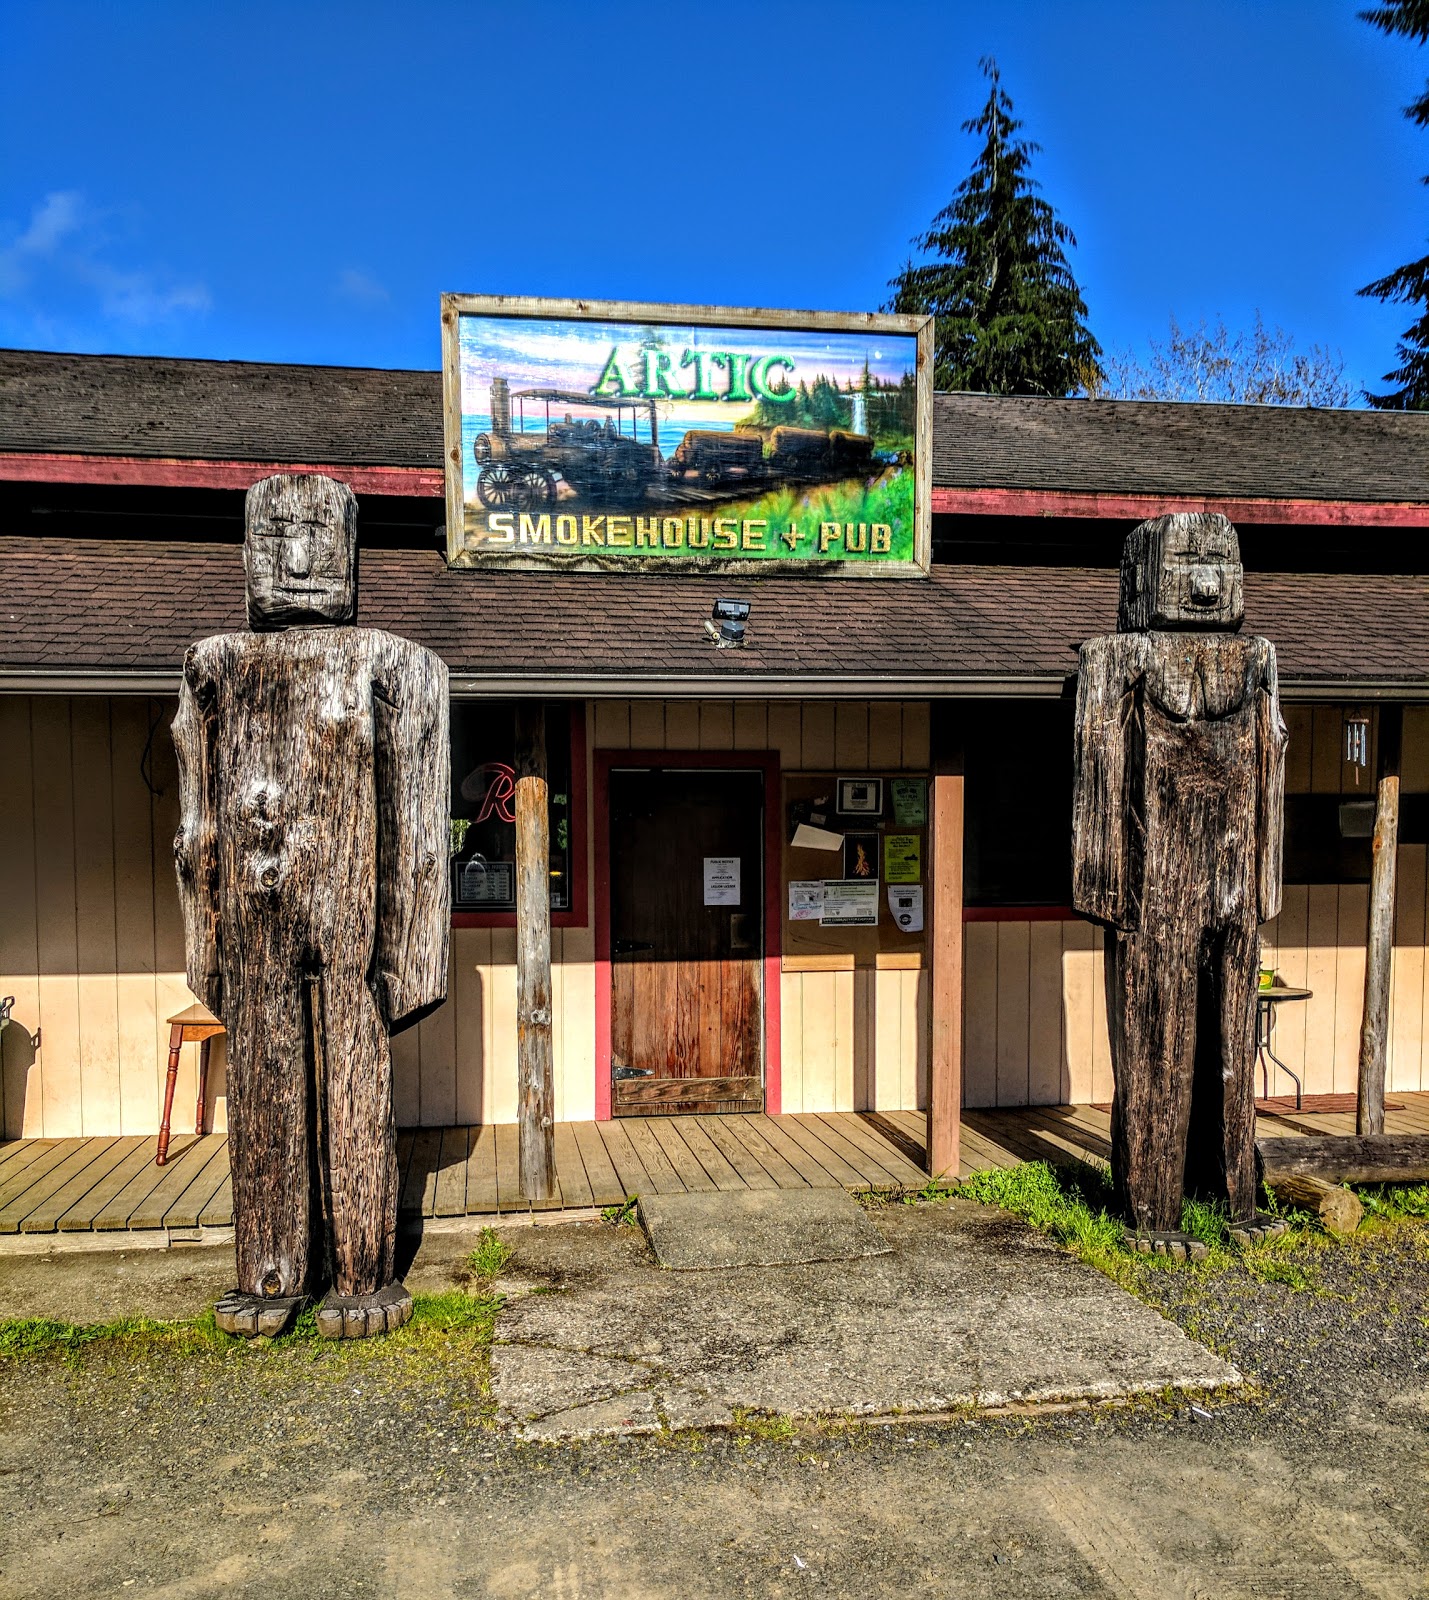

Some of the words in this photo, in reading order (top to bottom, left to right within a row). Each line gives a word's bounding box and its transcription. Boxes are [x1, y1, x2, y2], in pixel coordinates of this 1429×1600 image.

[589, 344, 797, 403] ARTIC
[487, 513, 768, 551] SMOKEHOUSE
[818, 521, 892, 554] PUB
[464, 762, 516, 824] R
